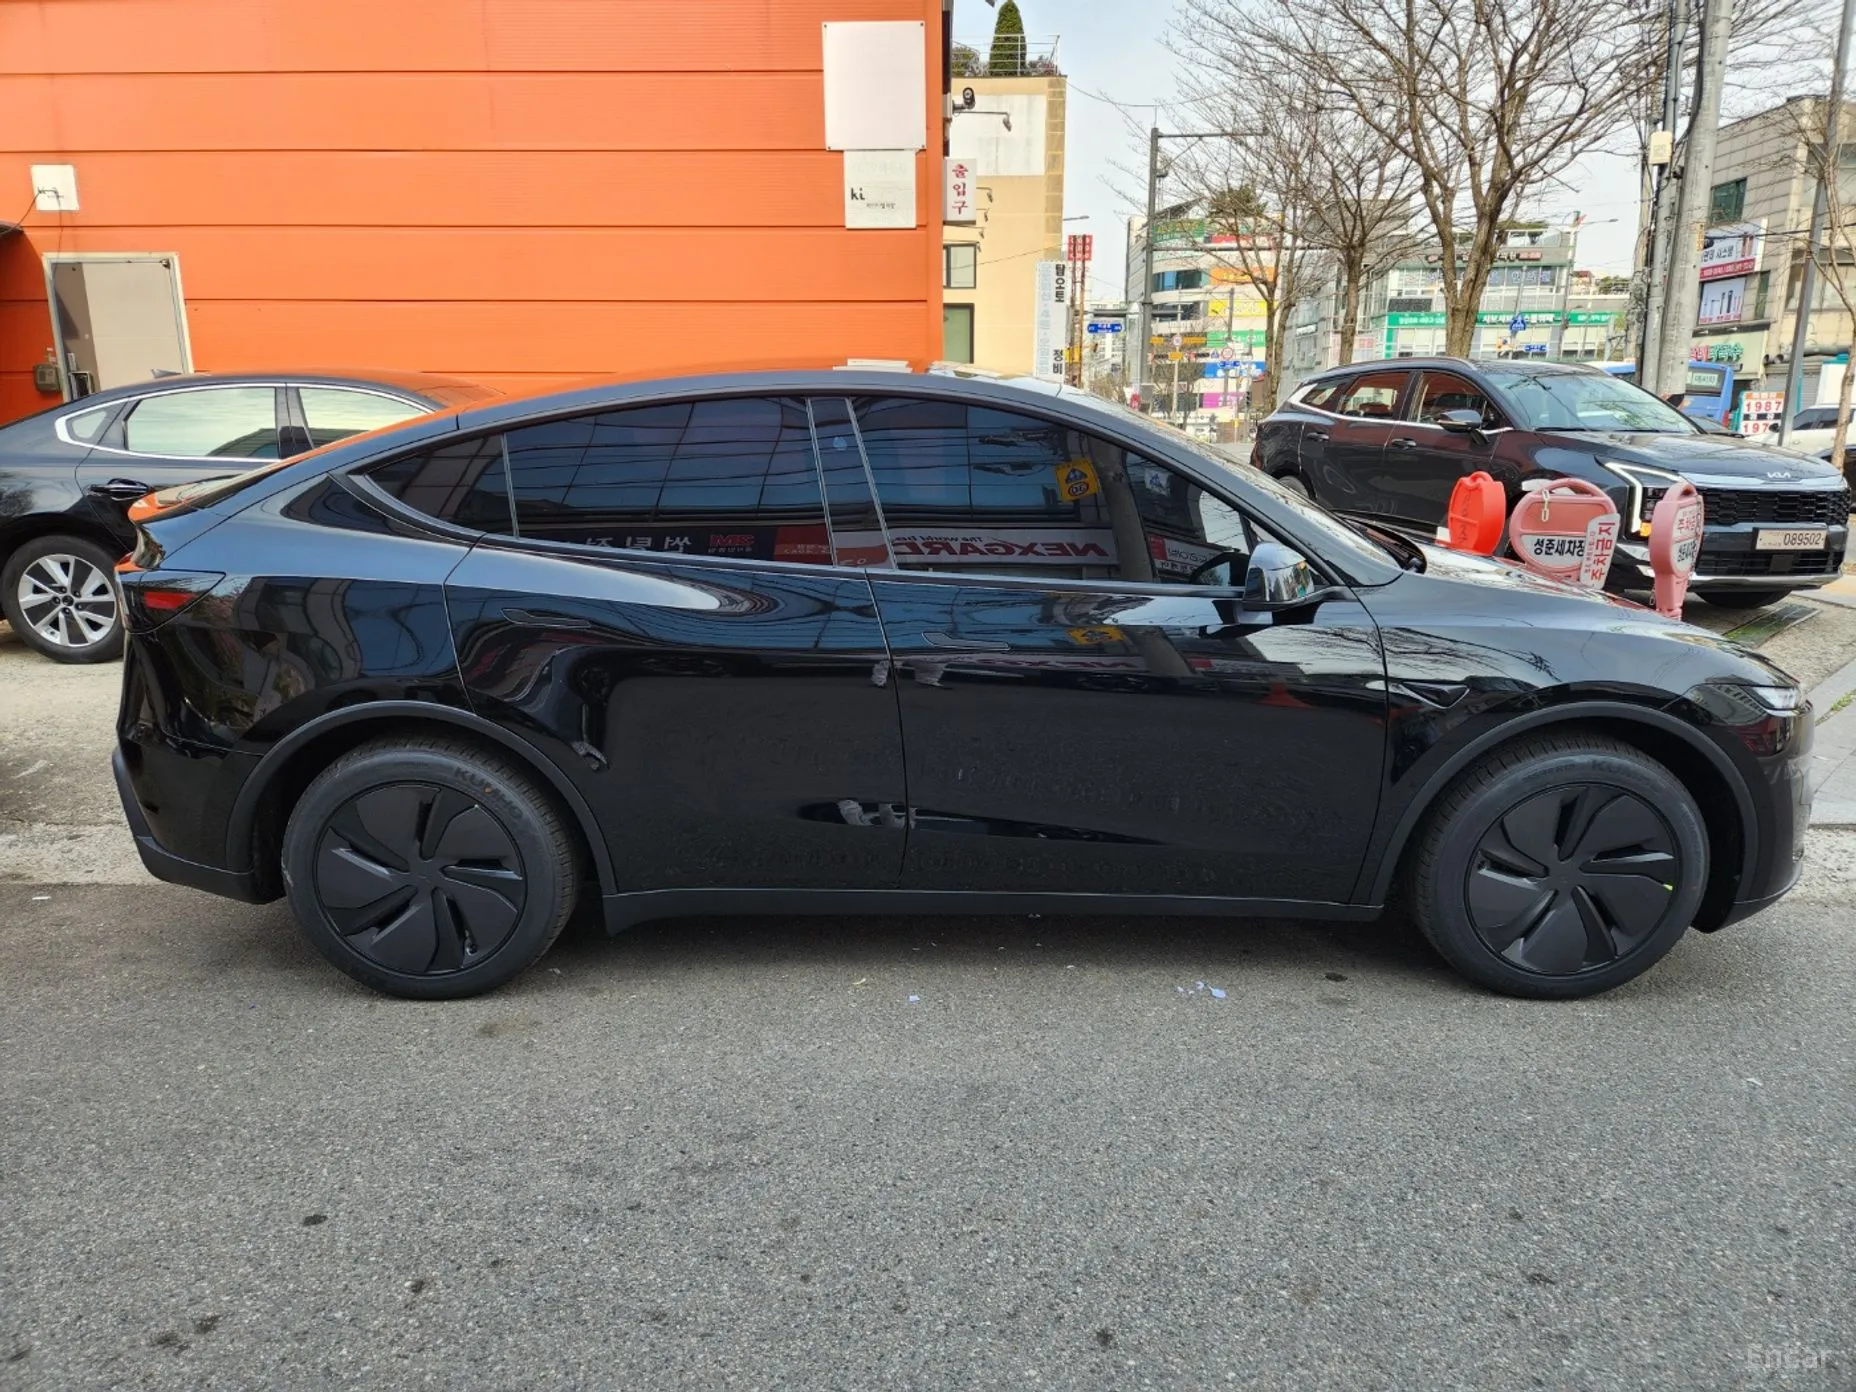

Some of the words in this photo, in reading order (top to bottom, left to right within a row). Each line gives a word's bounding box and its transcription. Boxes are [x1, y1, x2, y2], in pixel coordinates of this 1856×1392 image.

[951, 163, 969, 215] 출입구
[1745, 401, 1782, 412] 1987
[1743, 423, 1769, 434] 197
[1783, 532, 1822, 546] 089502
[1591, 521, 1616, 582] 주차금지
